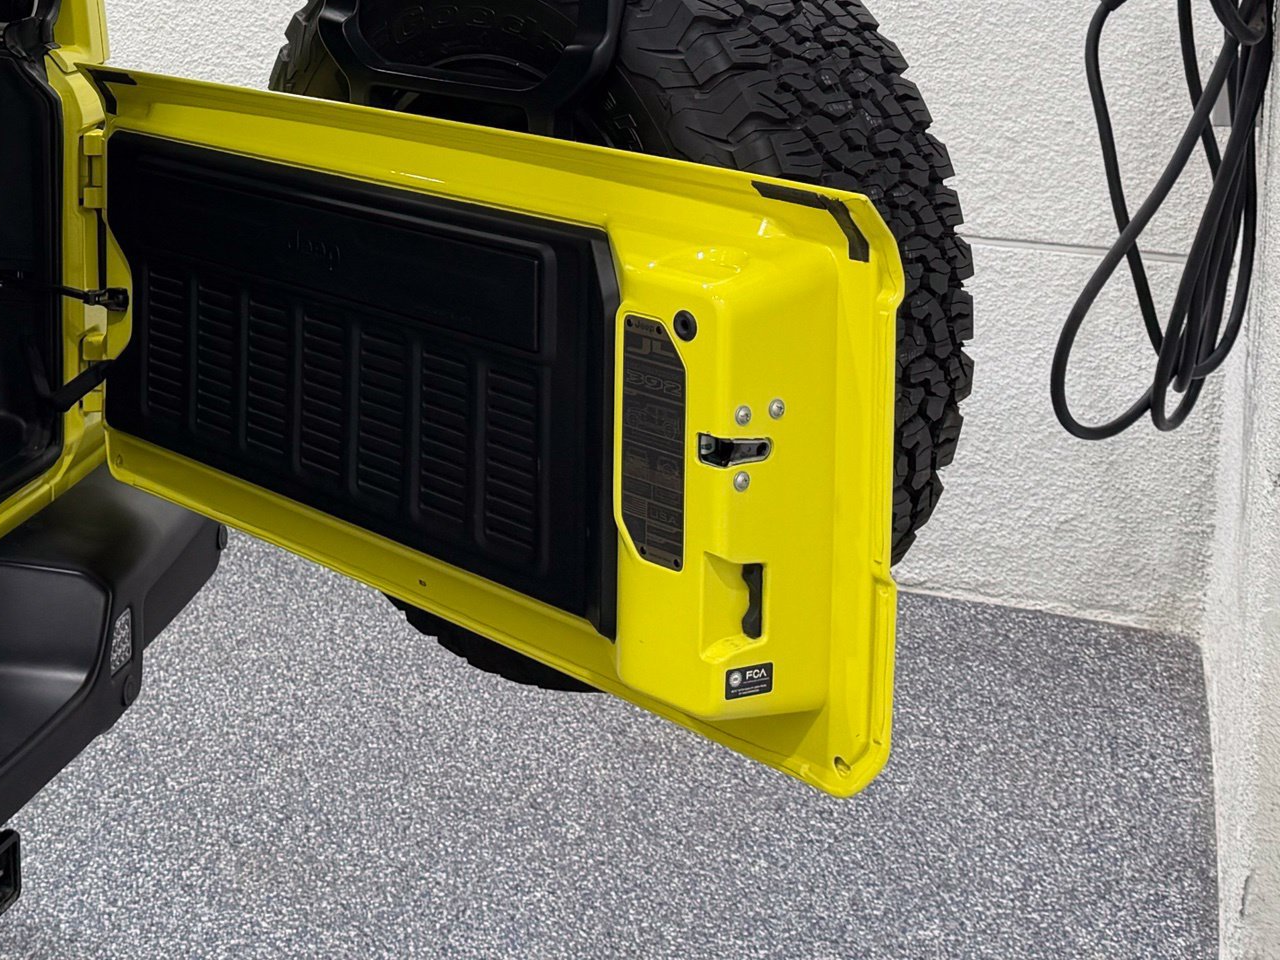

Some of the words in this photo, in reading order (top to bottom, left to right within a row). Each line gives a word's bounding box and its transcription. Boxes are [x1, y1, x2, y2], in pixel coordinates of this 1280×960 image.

[626, 337, 675, 358] JL
[626, 369, 682, 397] 392
[746, 668, 767, 680] FCA
